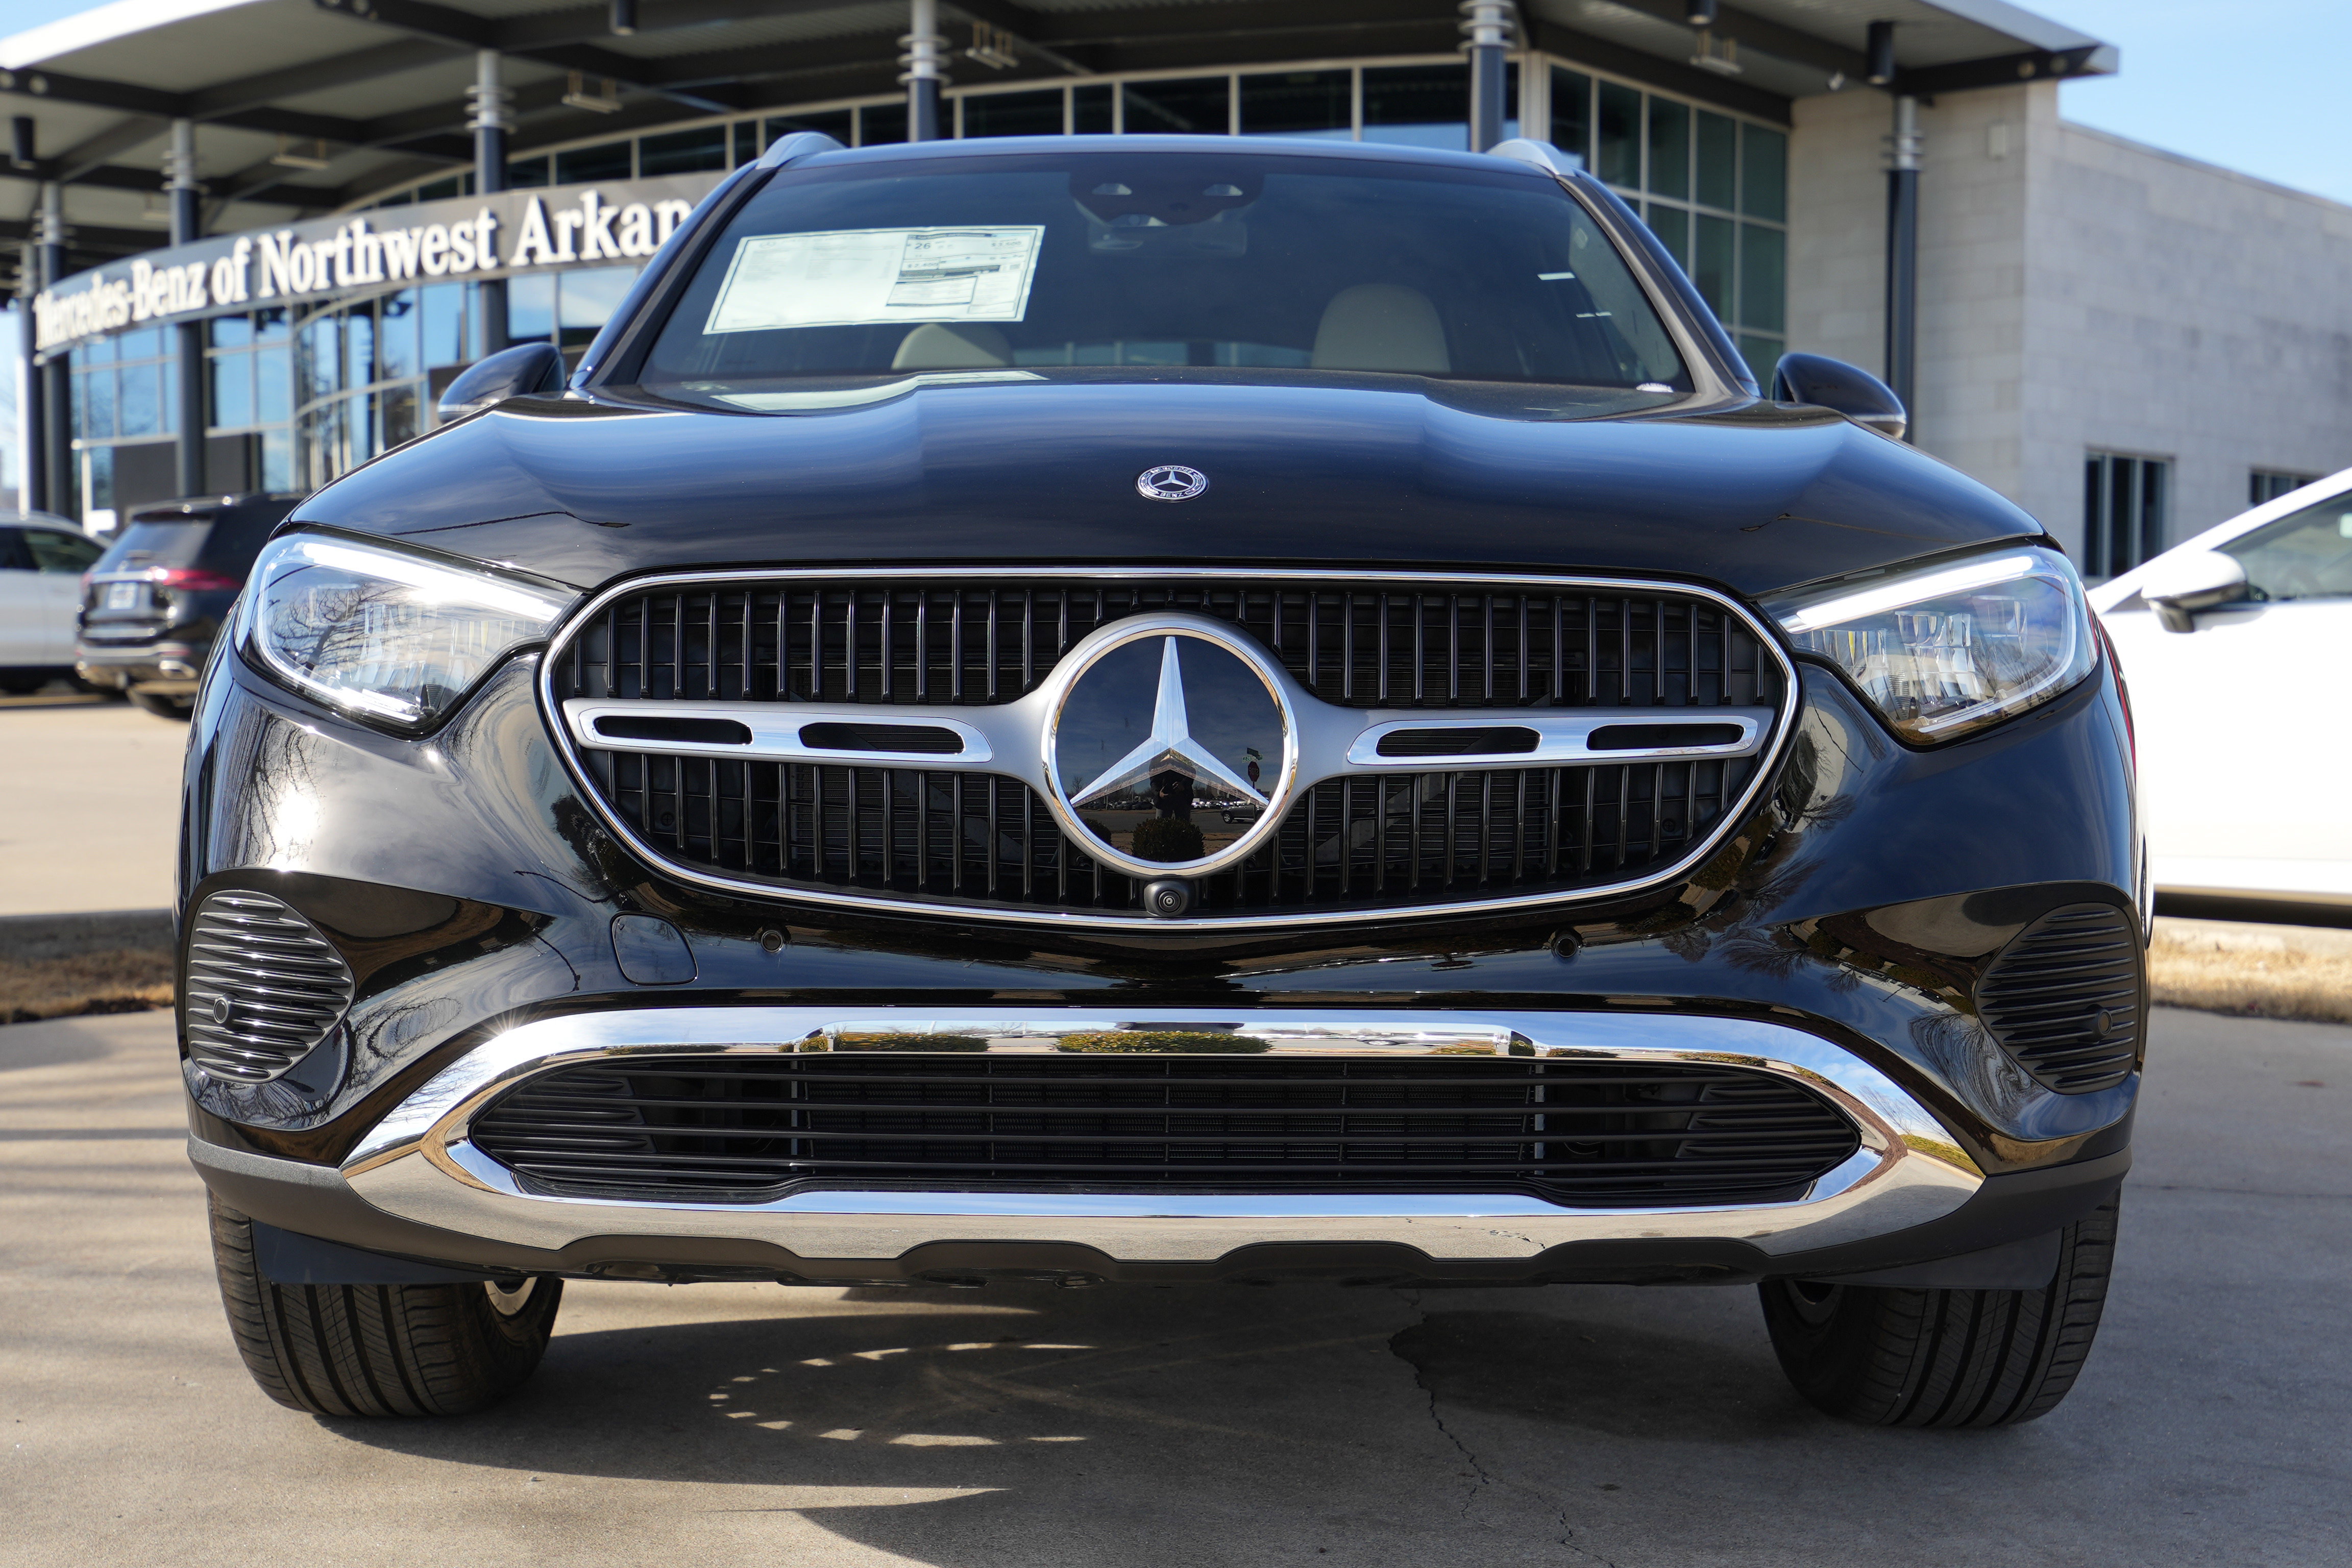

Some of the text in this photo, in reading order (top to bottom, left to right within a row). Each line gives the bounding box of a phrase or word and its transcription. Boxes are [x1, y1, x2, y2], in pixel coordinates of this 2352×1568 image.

[34, 259, 207, 350] Mercedes-Benz
[212, 236, 252, 305] of
[257, 206, 498, 297] Northwest
